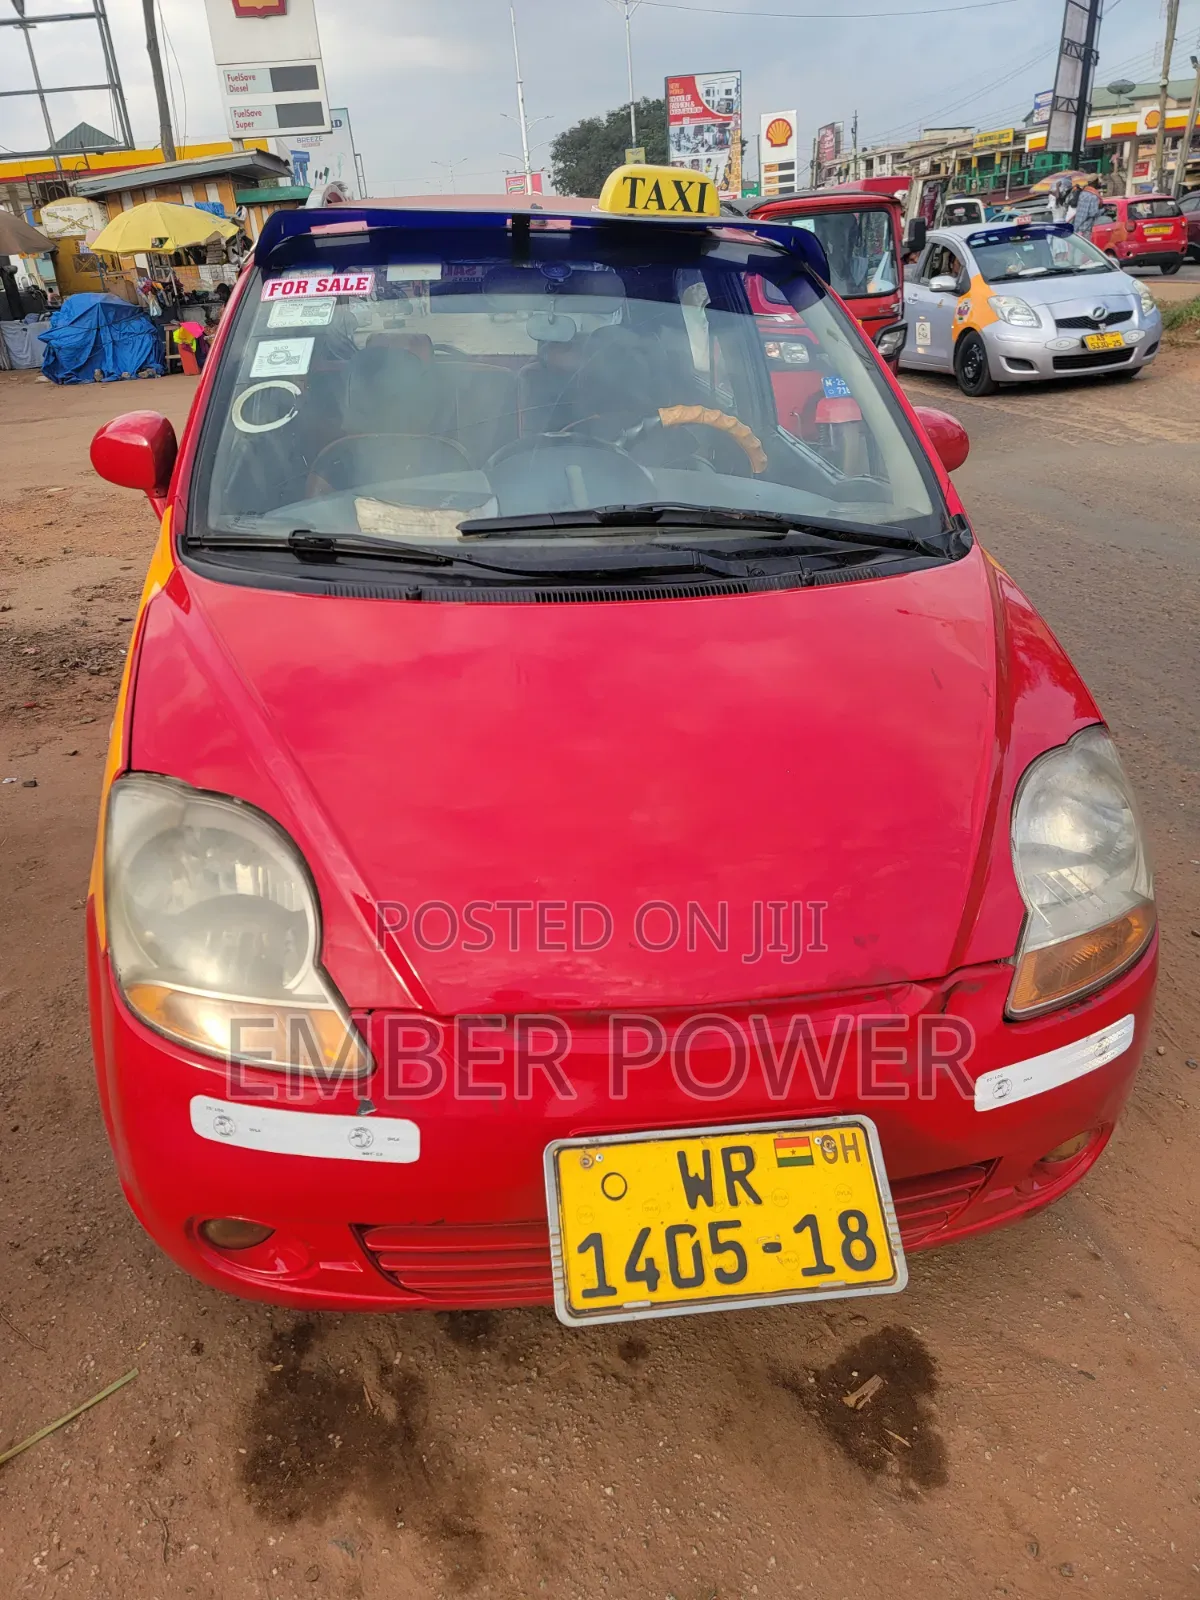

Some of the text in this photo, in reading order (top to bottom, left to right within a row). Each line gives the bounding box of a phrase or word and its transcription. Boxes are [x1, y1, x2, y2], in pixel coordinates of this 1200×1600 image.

[227, 72, 257, 82] FuelSave
[229, 83, 249, 93] Diesel
[233, 109, 262, 118] FuelSave
[235, 121, 254, 131] Super
[296, 135, 323, 143] BREEZE
[622, 176, 711, 213] TAXI
[268, 277, 369, 297] FOR SALE
[677, 1145, 763, 1210] WR
[577, 1209, 877, 1299] 1405-18
